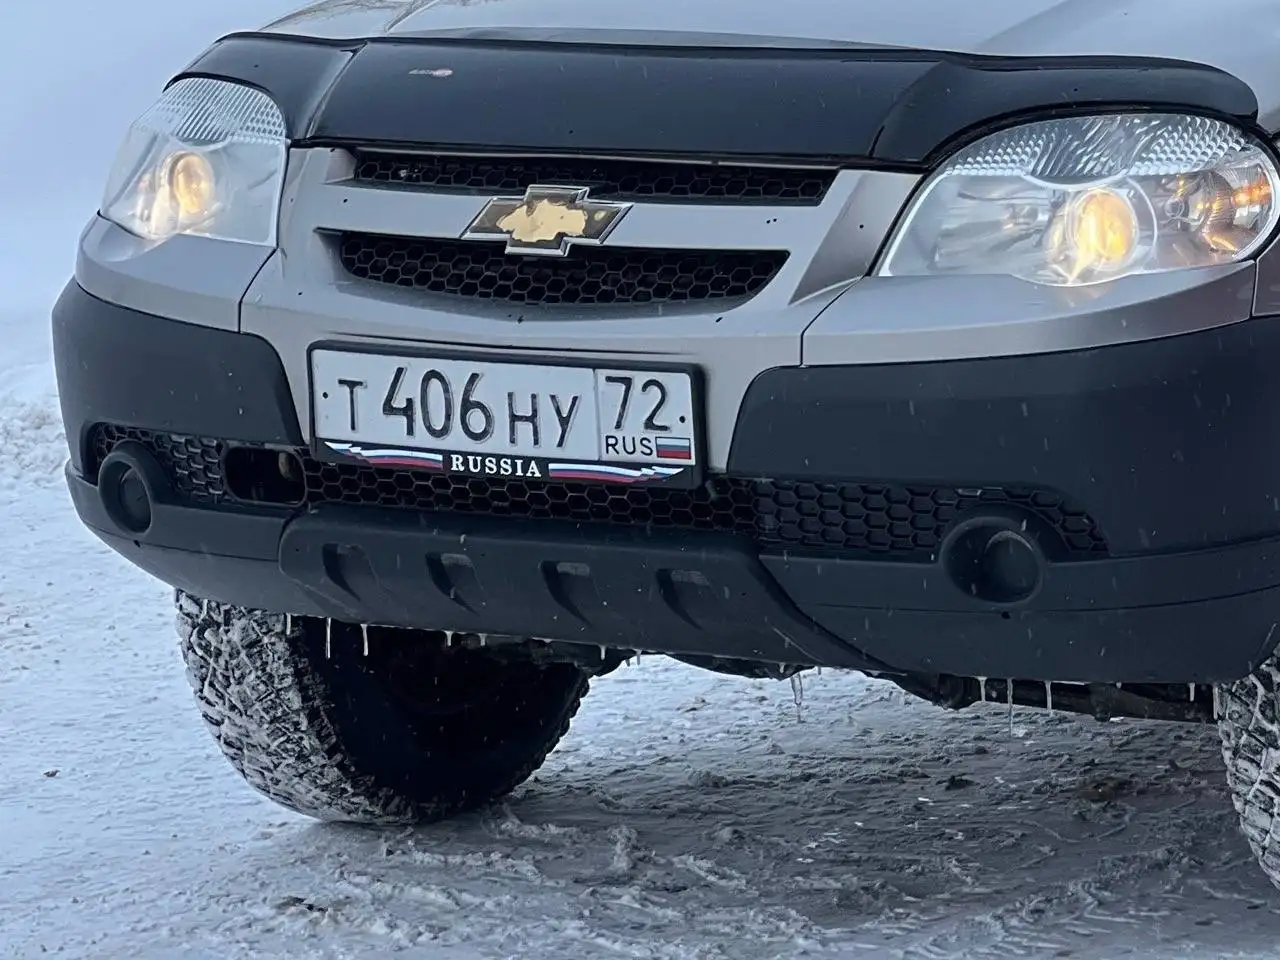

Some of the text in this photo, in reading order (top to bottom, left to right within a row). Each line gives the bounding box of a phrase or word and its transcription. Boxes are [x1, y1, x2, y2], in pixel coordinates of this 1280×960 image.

[604, 375, 670, 433] 72
[605, 435, 654, 456] RUS
[449, 454, 543, 478] RUSSIA
